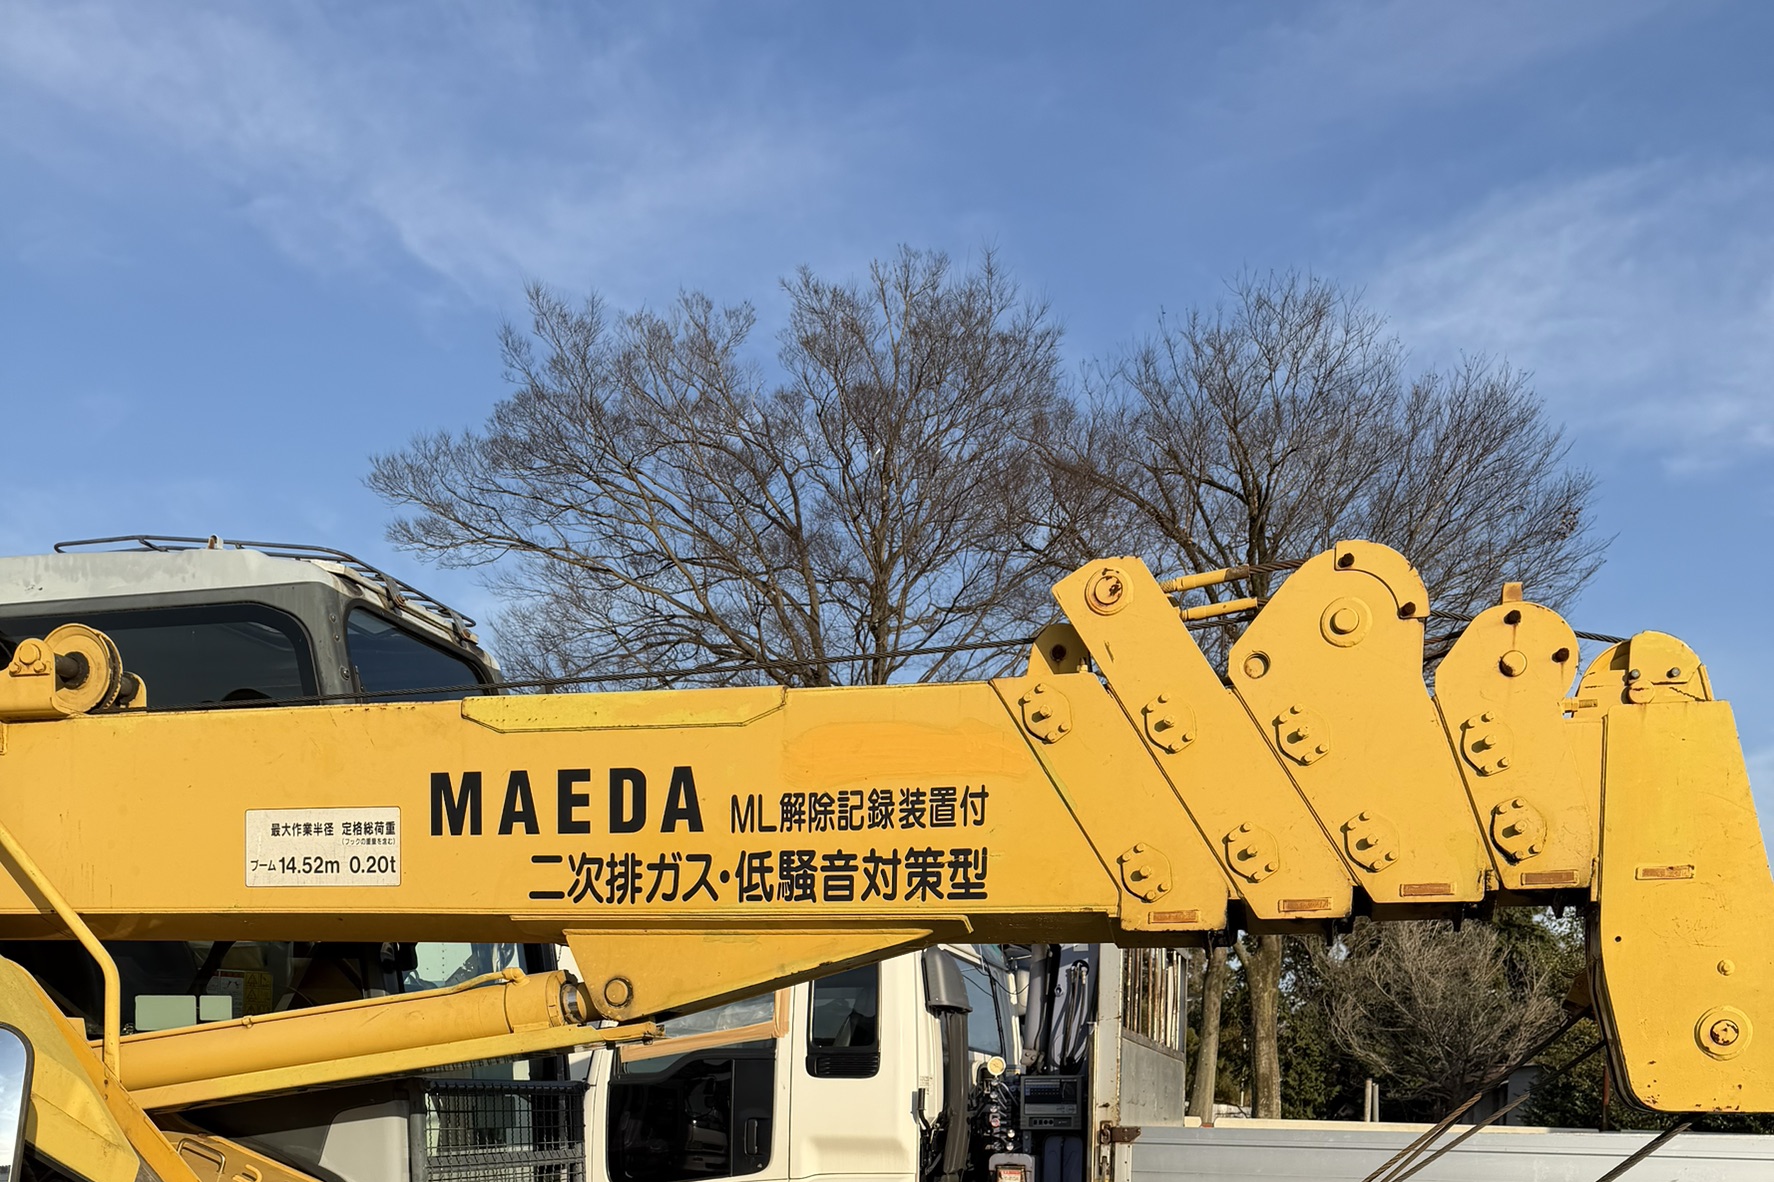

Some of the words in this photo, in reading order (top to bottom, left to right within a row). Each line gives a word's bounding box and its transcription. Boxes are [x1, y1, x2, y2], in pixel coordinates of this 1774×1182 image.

[430, 766, 705, 836] MAEDA
[731, 784, 989, 834] ML解除記録装置付
[270, 822, 334, 837] 最大作業半径
[341, 821, 396, 836] 定格総荷重
[250, 859, 276, 872] ブーム
[278, 856, 340, 874] 14.52m
[349, 855, 396, 874] 0.20t
[528, 847, 988, 905] 二次排ガス・低騒音対策型
